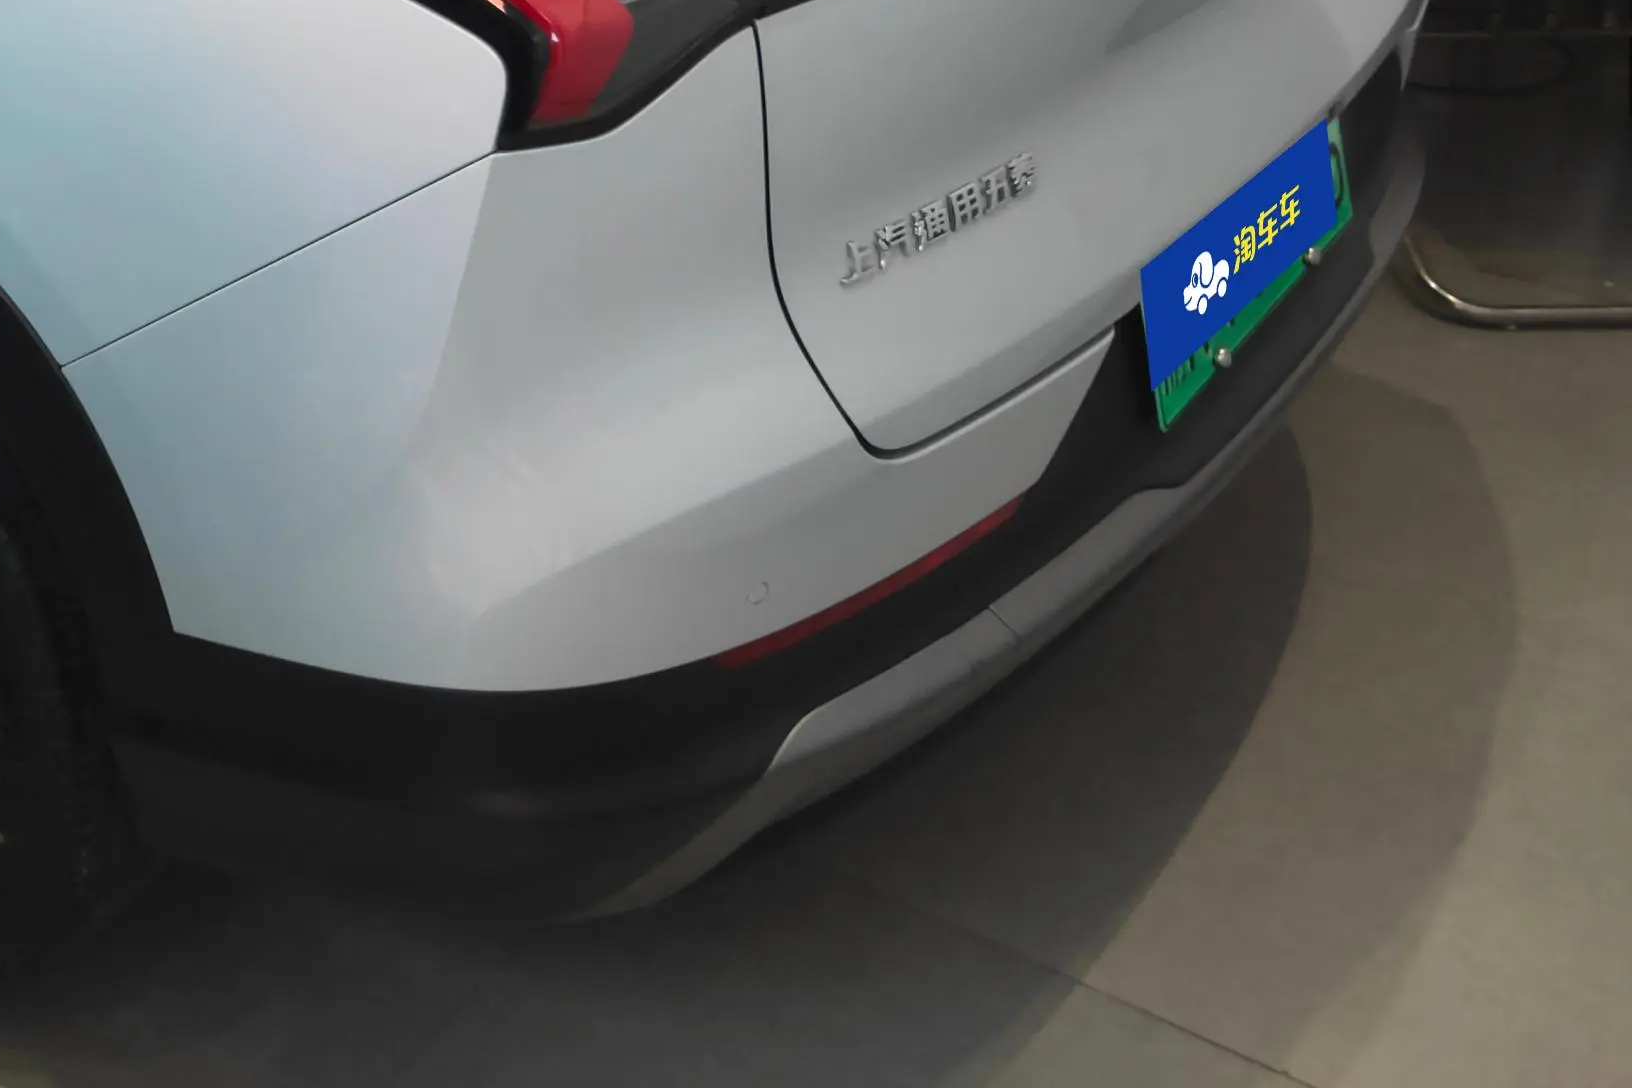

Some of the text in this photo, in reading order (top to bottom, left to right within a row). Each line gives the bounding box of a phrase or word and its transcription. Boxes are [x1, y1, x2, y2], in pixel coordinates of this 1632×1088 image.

[840, 152, 1036, 288] 上汽通用五菱
